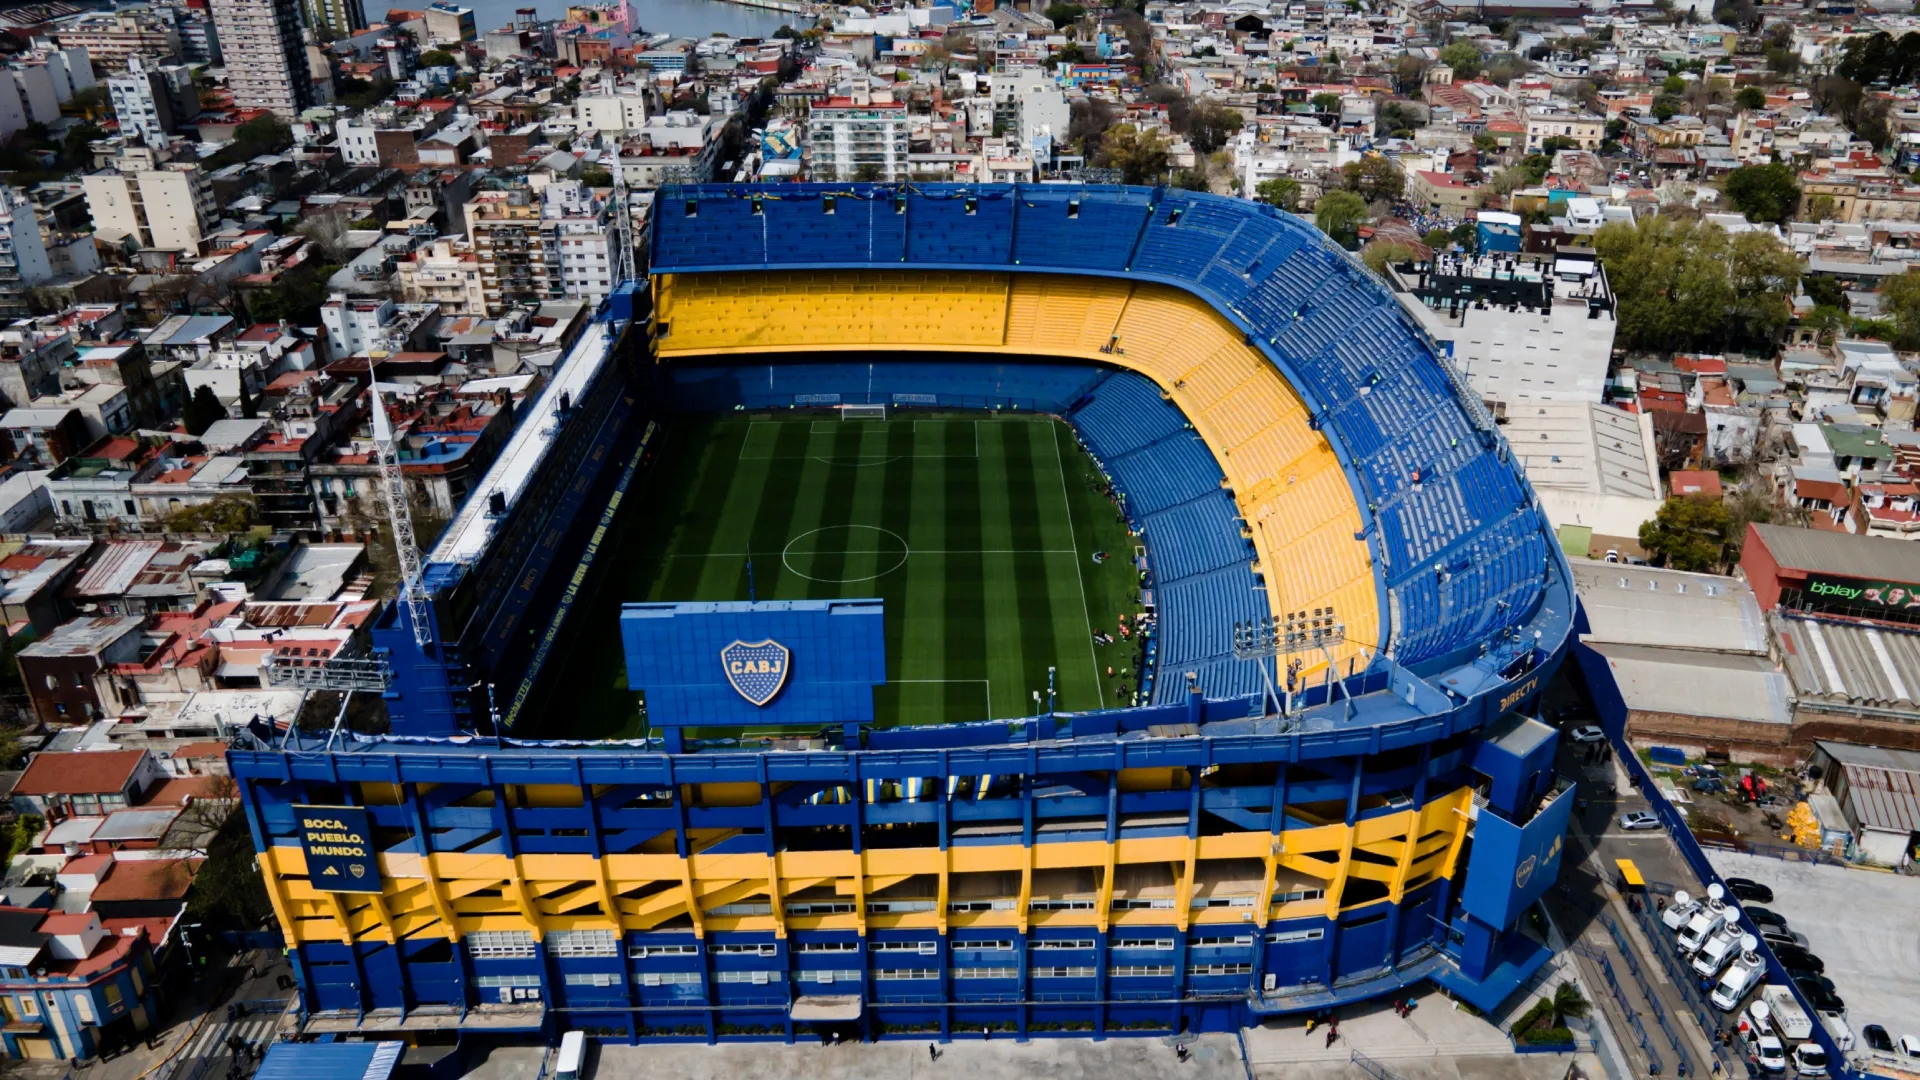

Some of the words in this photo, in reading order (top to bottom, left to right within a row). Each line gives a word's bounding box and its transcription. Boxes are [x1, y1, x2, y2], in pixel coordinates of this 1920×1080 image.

[587, 544, 597, 553] LA
[567, 584, 577, 595] LA
[572, 563, 588, 585] NUEVA
[731, 661, 781, 674] CABJ
[1499, 676, 1538, 712] DIRECTV
[303, 819, 348, 830] BOCA,
[307, 833, 364, 844] PUEBLO,
[310, 846, 366, 856] MUNDO.
